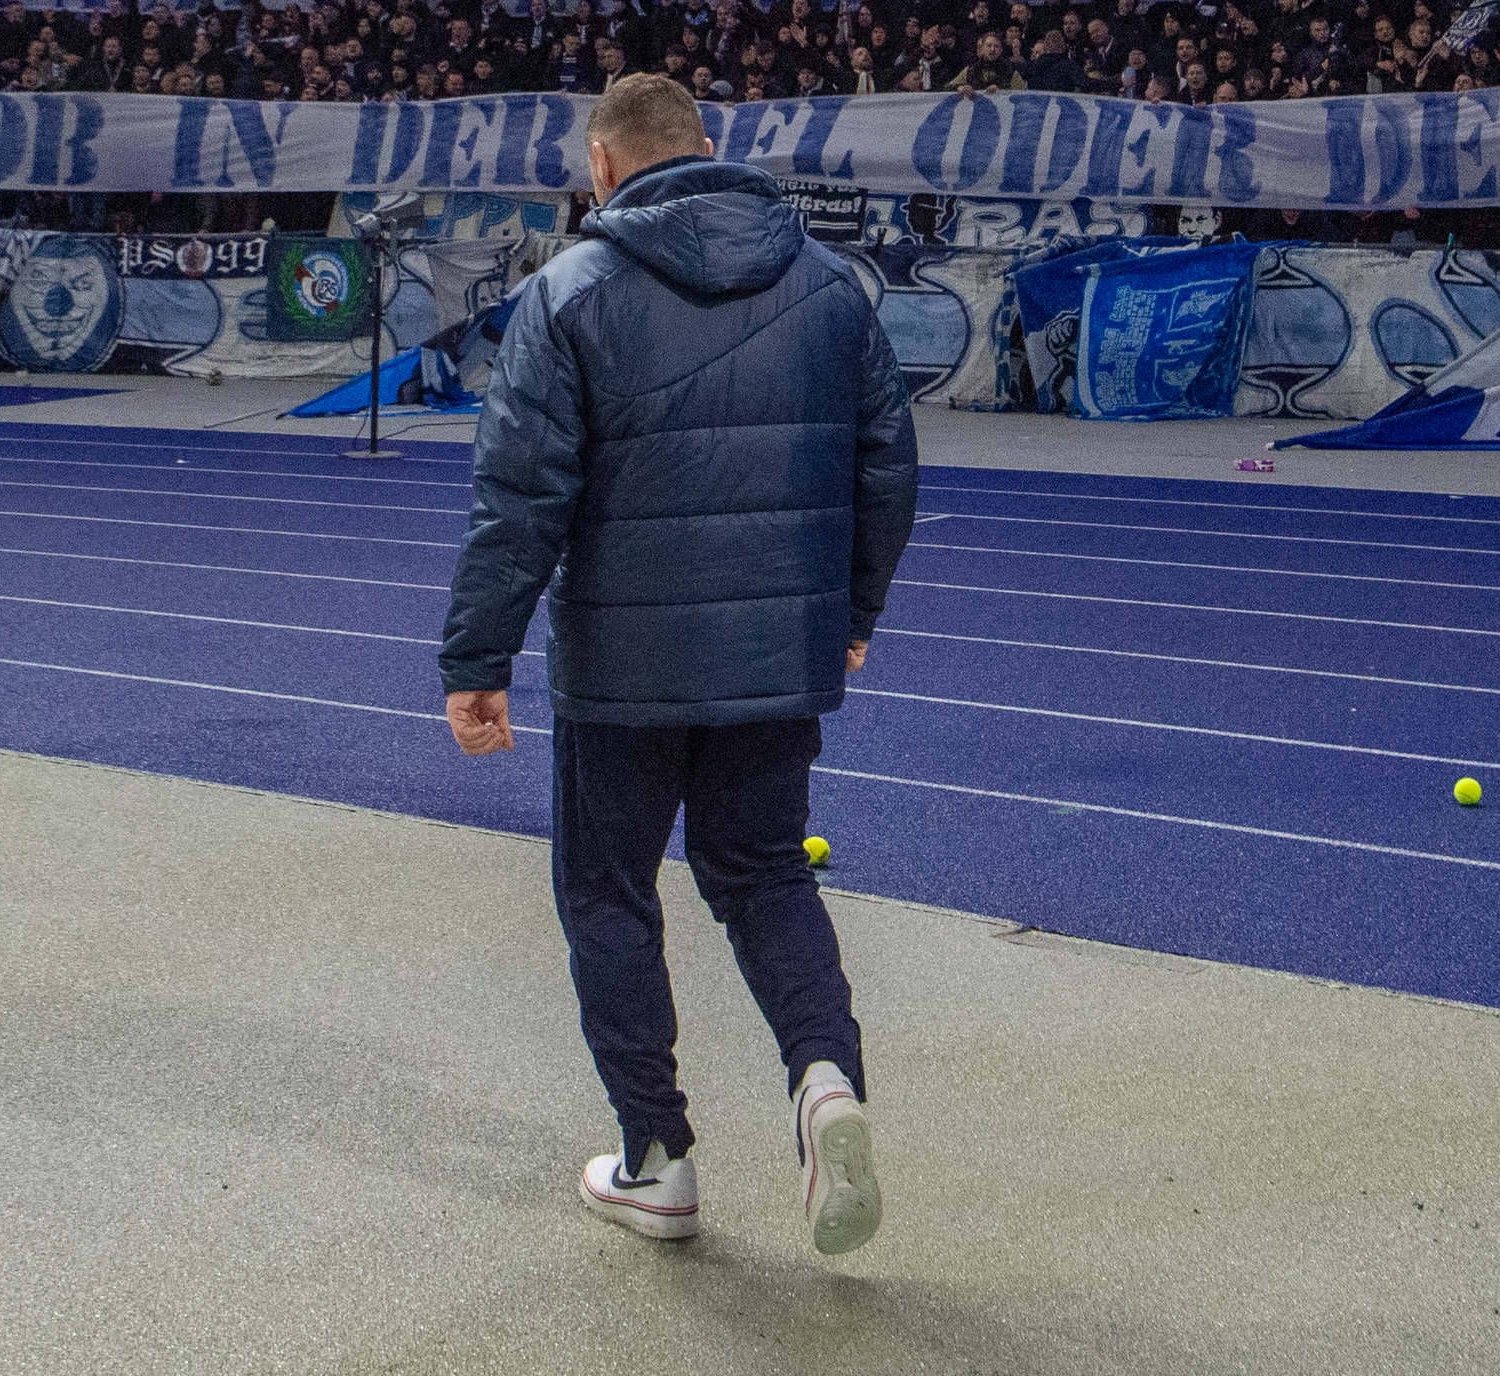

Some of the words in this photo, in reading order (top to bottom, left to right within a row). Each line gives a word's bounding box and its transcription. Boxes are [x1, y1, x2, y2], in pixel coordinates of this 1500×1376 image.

[174, 99, 296, 188] IN
[350, 94, 571, 191] DER
[909, 91, 1264, 204] ODER
